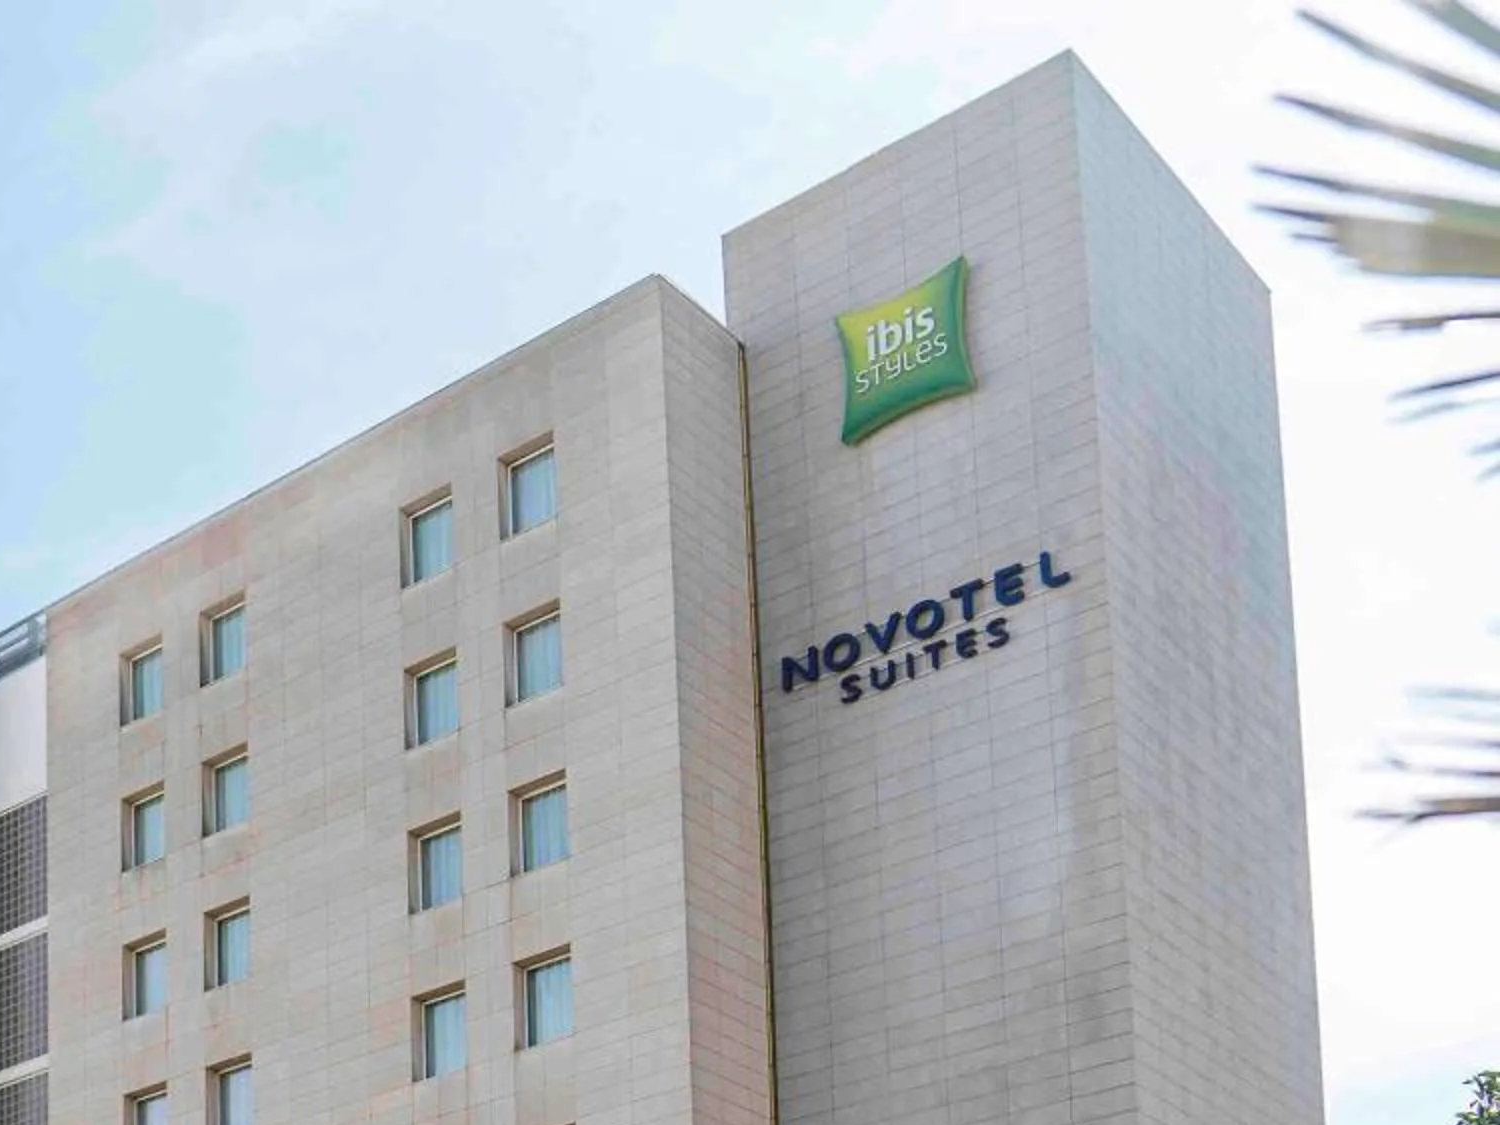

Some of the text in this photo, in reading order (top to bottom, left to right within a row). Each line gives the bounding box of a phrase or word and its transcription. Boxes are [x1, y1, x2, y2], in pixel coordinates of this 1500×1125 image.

[867, 306, 935, 361] ibis
[781, 550, 1071, 693] NOVOTEL
[840, 617, 1011, 704] SUITES
